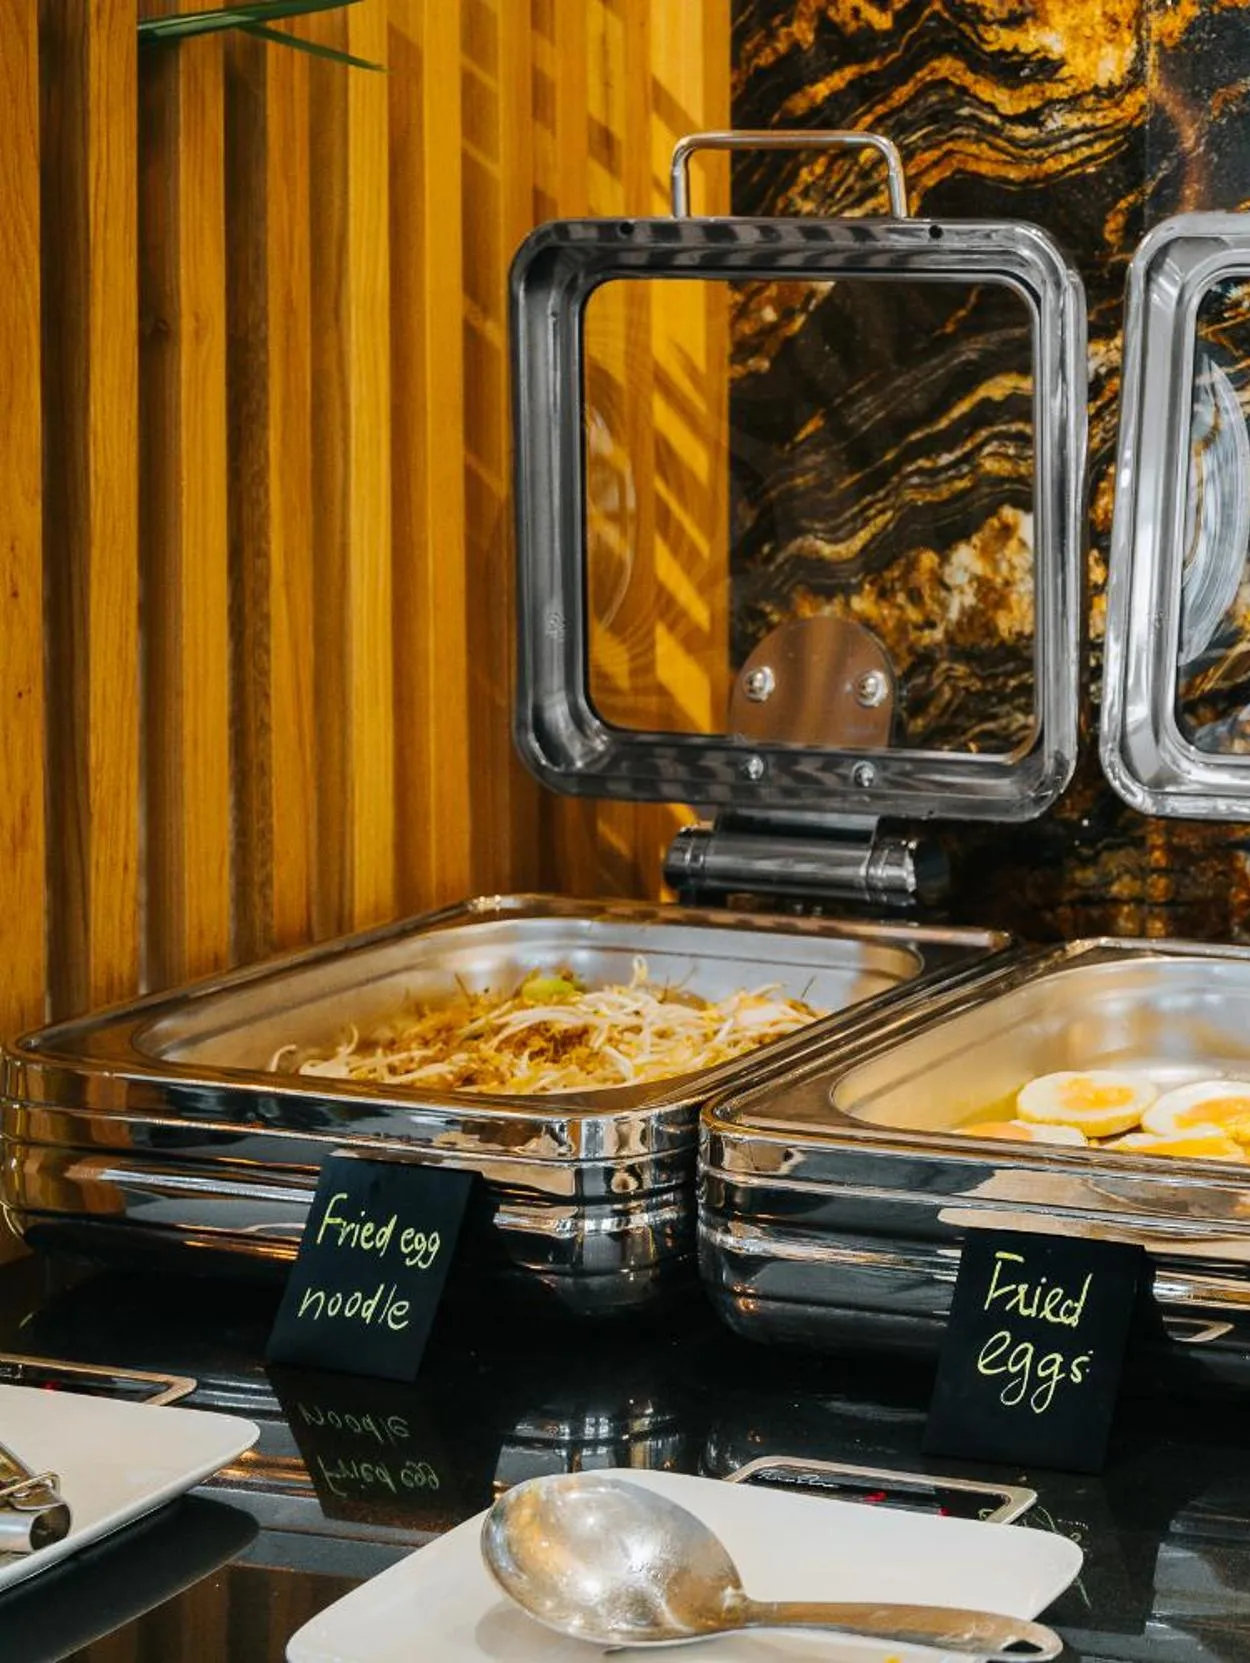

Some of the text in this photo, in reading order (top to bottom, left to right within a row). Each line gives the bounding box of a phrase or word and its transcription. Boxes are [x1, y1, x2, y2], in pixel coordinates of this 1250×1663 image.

[316, 1192, 441, 1269] Fried egg
[297, 1283, 410, 1330] noodle
[983, 1250, 1093, 1327] Fried
[977, 1330, 1094, 1414] eggs
